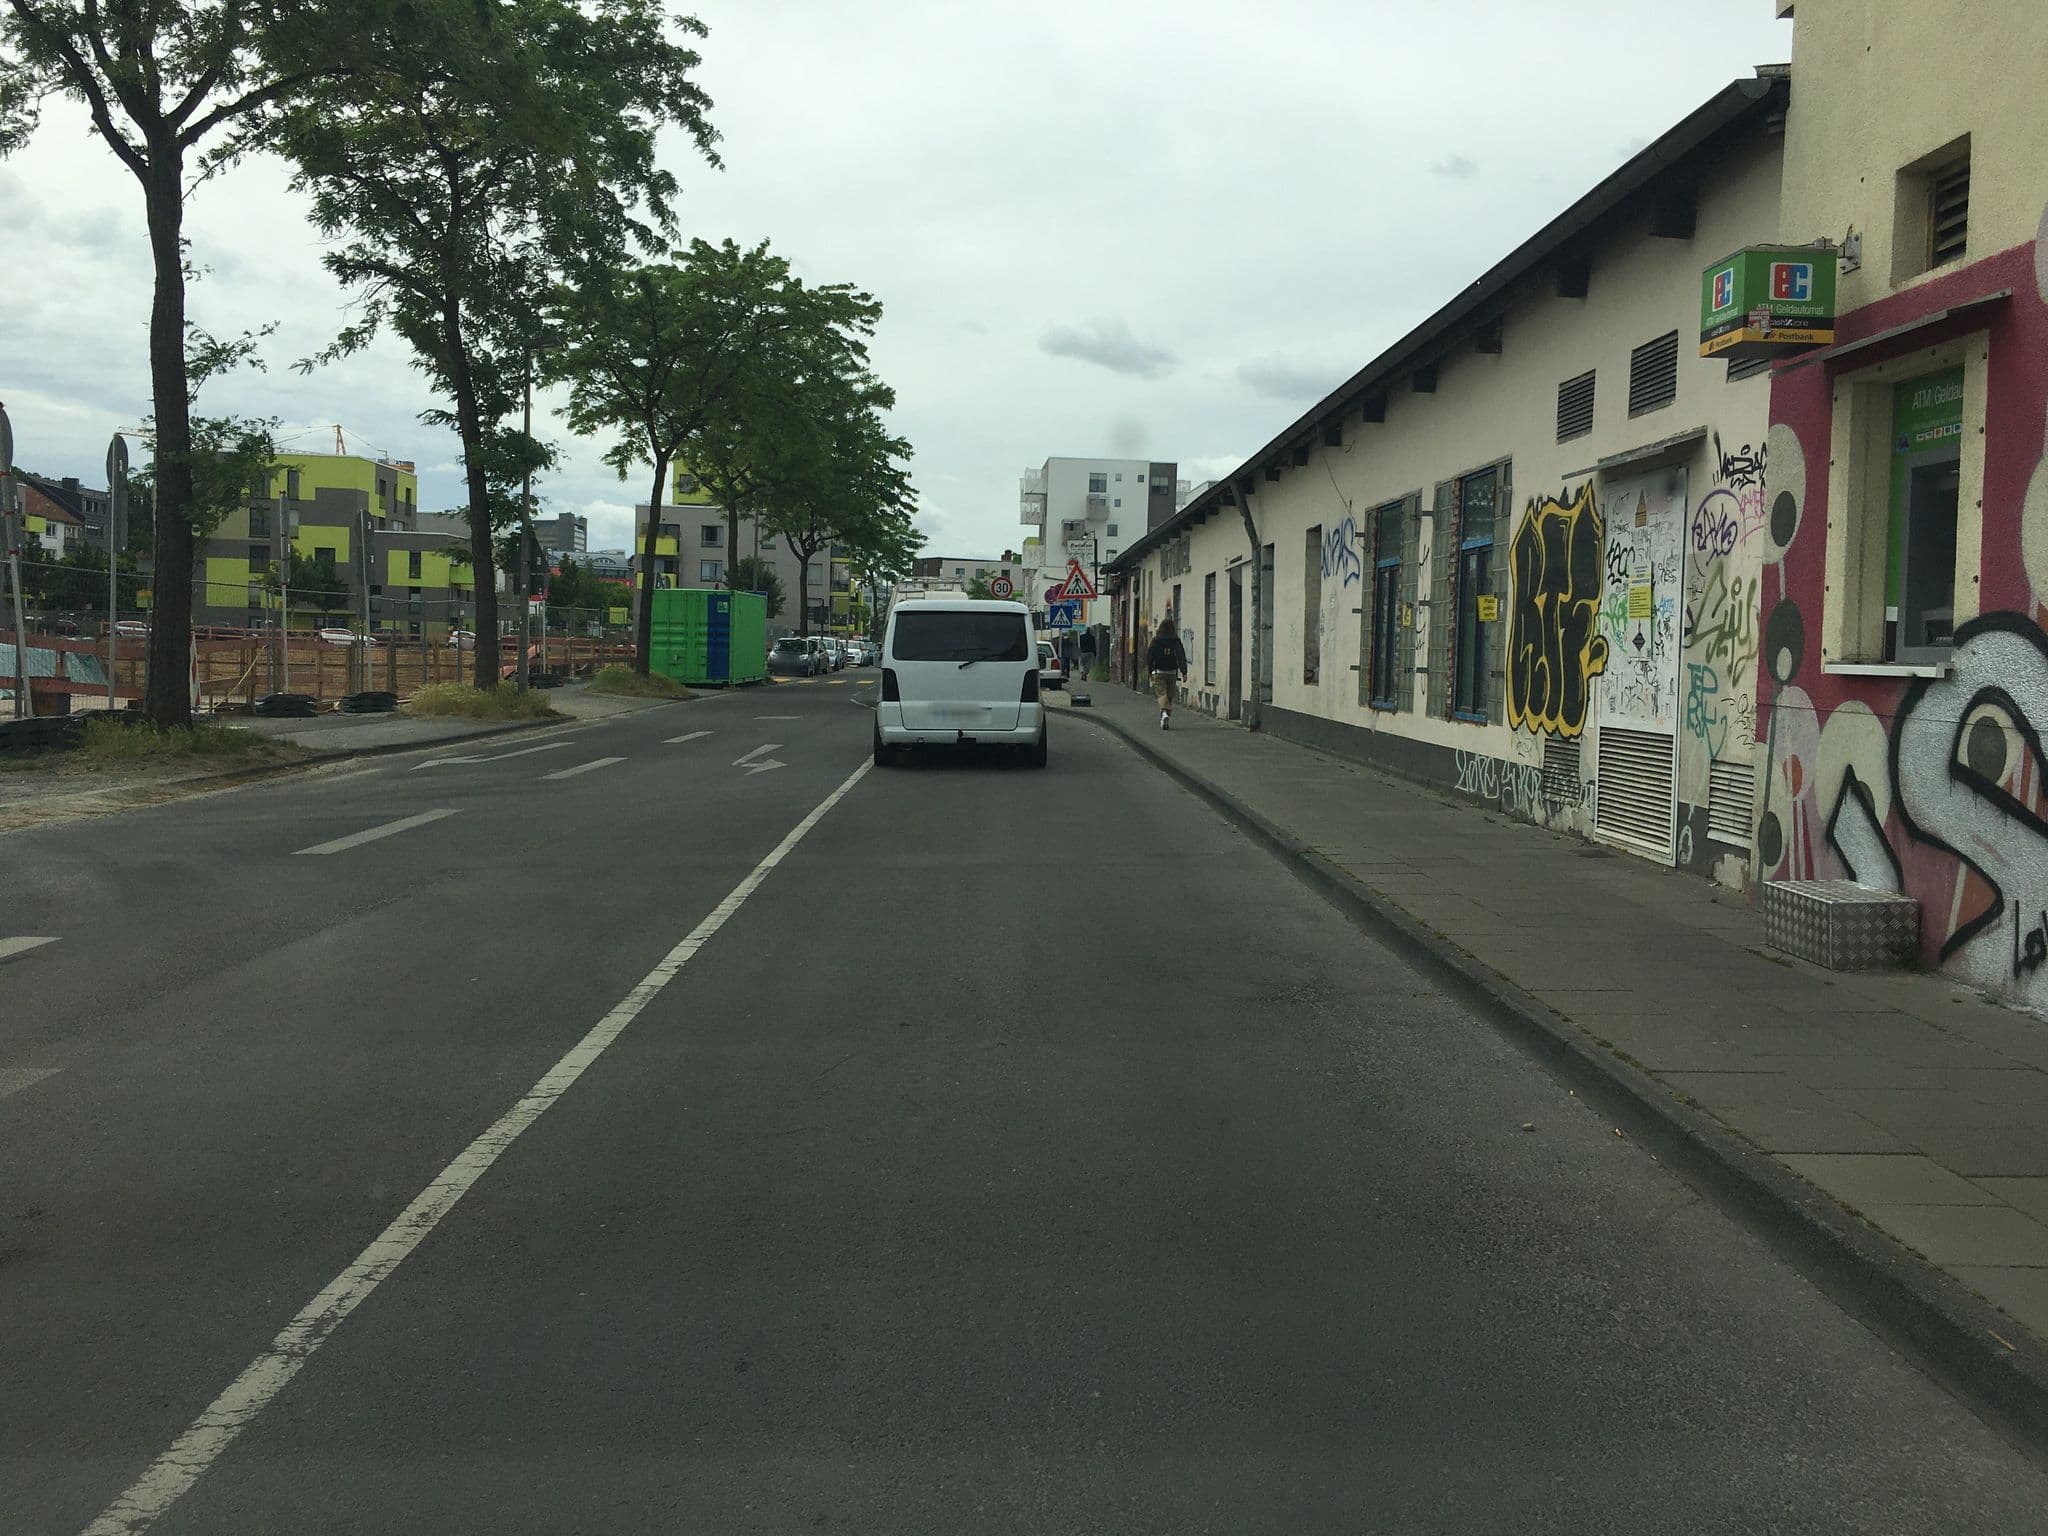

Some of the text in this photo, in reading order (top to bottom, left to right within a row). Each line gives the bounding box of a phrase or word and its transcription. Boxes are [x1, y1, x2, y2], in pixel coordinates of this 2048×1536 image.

[1775, 303, 1824, 315] Geldautomat
[1778, 332, 1814, 340] Postbank
[1912, 389, 1931, 409] ATM
[995, 583, 1009, 594] 30
